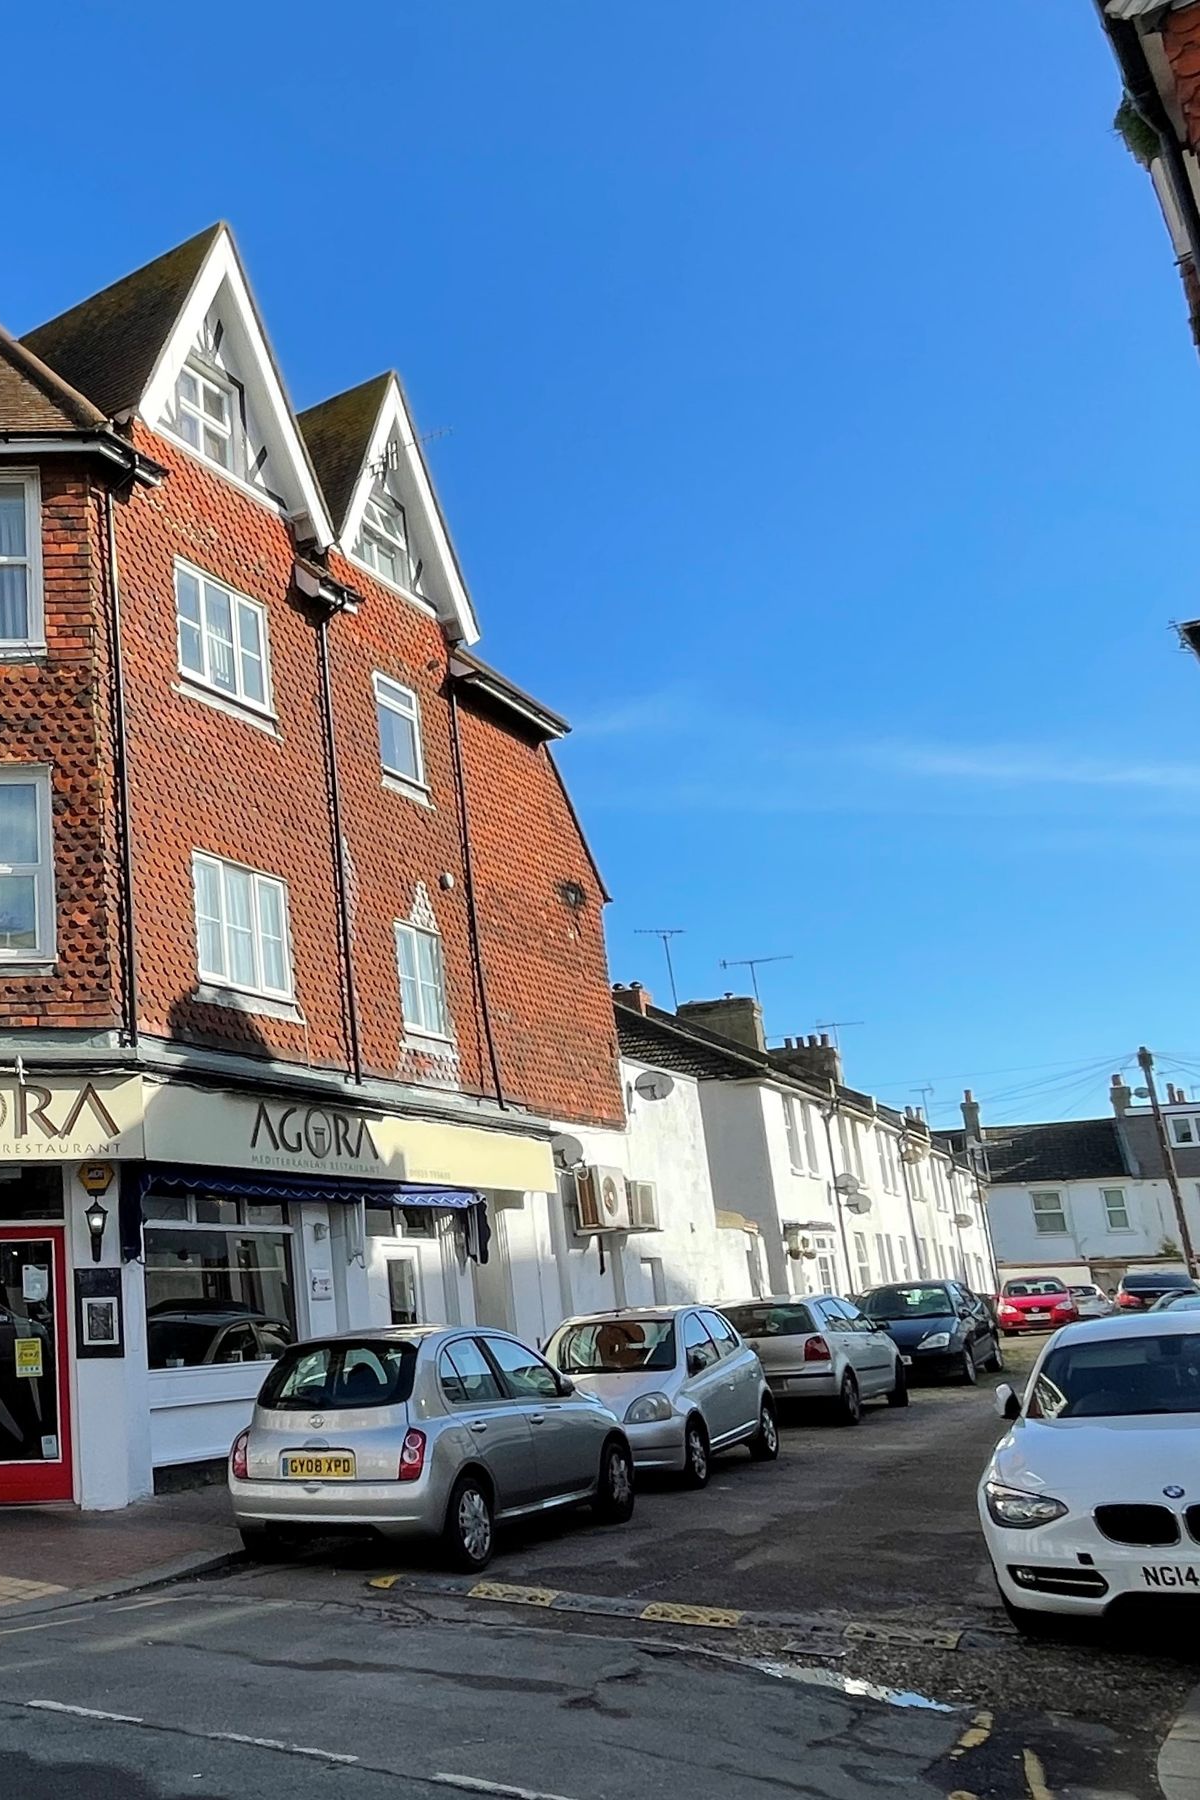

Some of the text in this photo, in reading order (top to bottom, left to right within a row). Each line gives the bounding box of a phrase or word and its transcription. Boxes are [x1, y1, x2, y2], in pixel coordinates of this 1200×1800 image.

[250, 1101, 379, 1160] AGORA
[3, 1142, 122, 1155] RESTAURANT
[251, 1154, 327, 1170] MEDITERRANEAN
[290, 1459, 350, 1473] GY08 XPD
[1142, 1566, 1200, 1586] NG14
